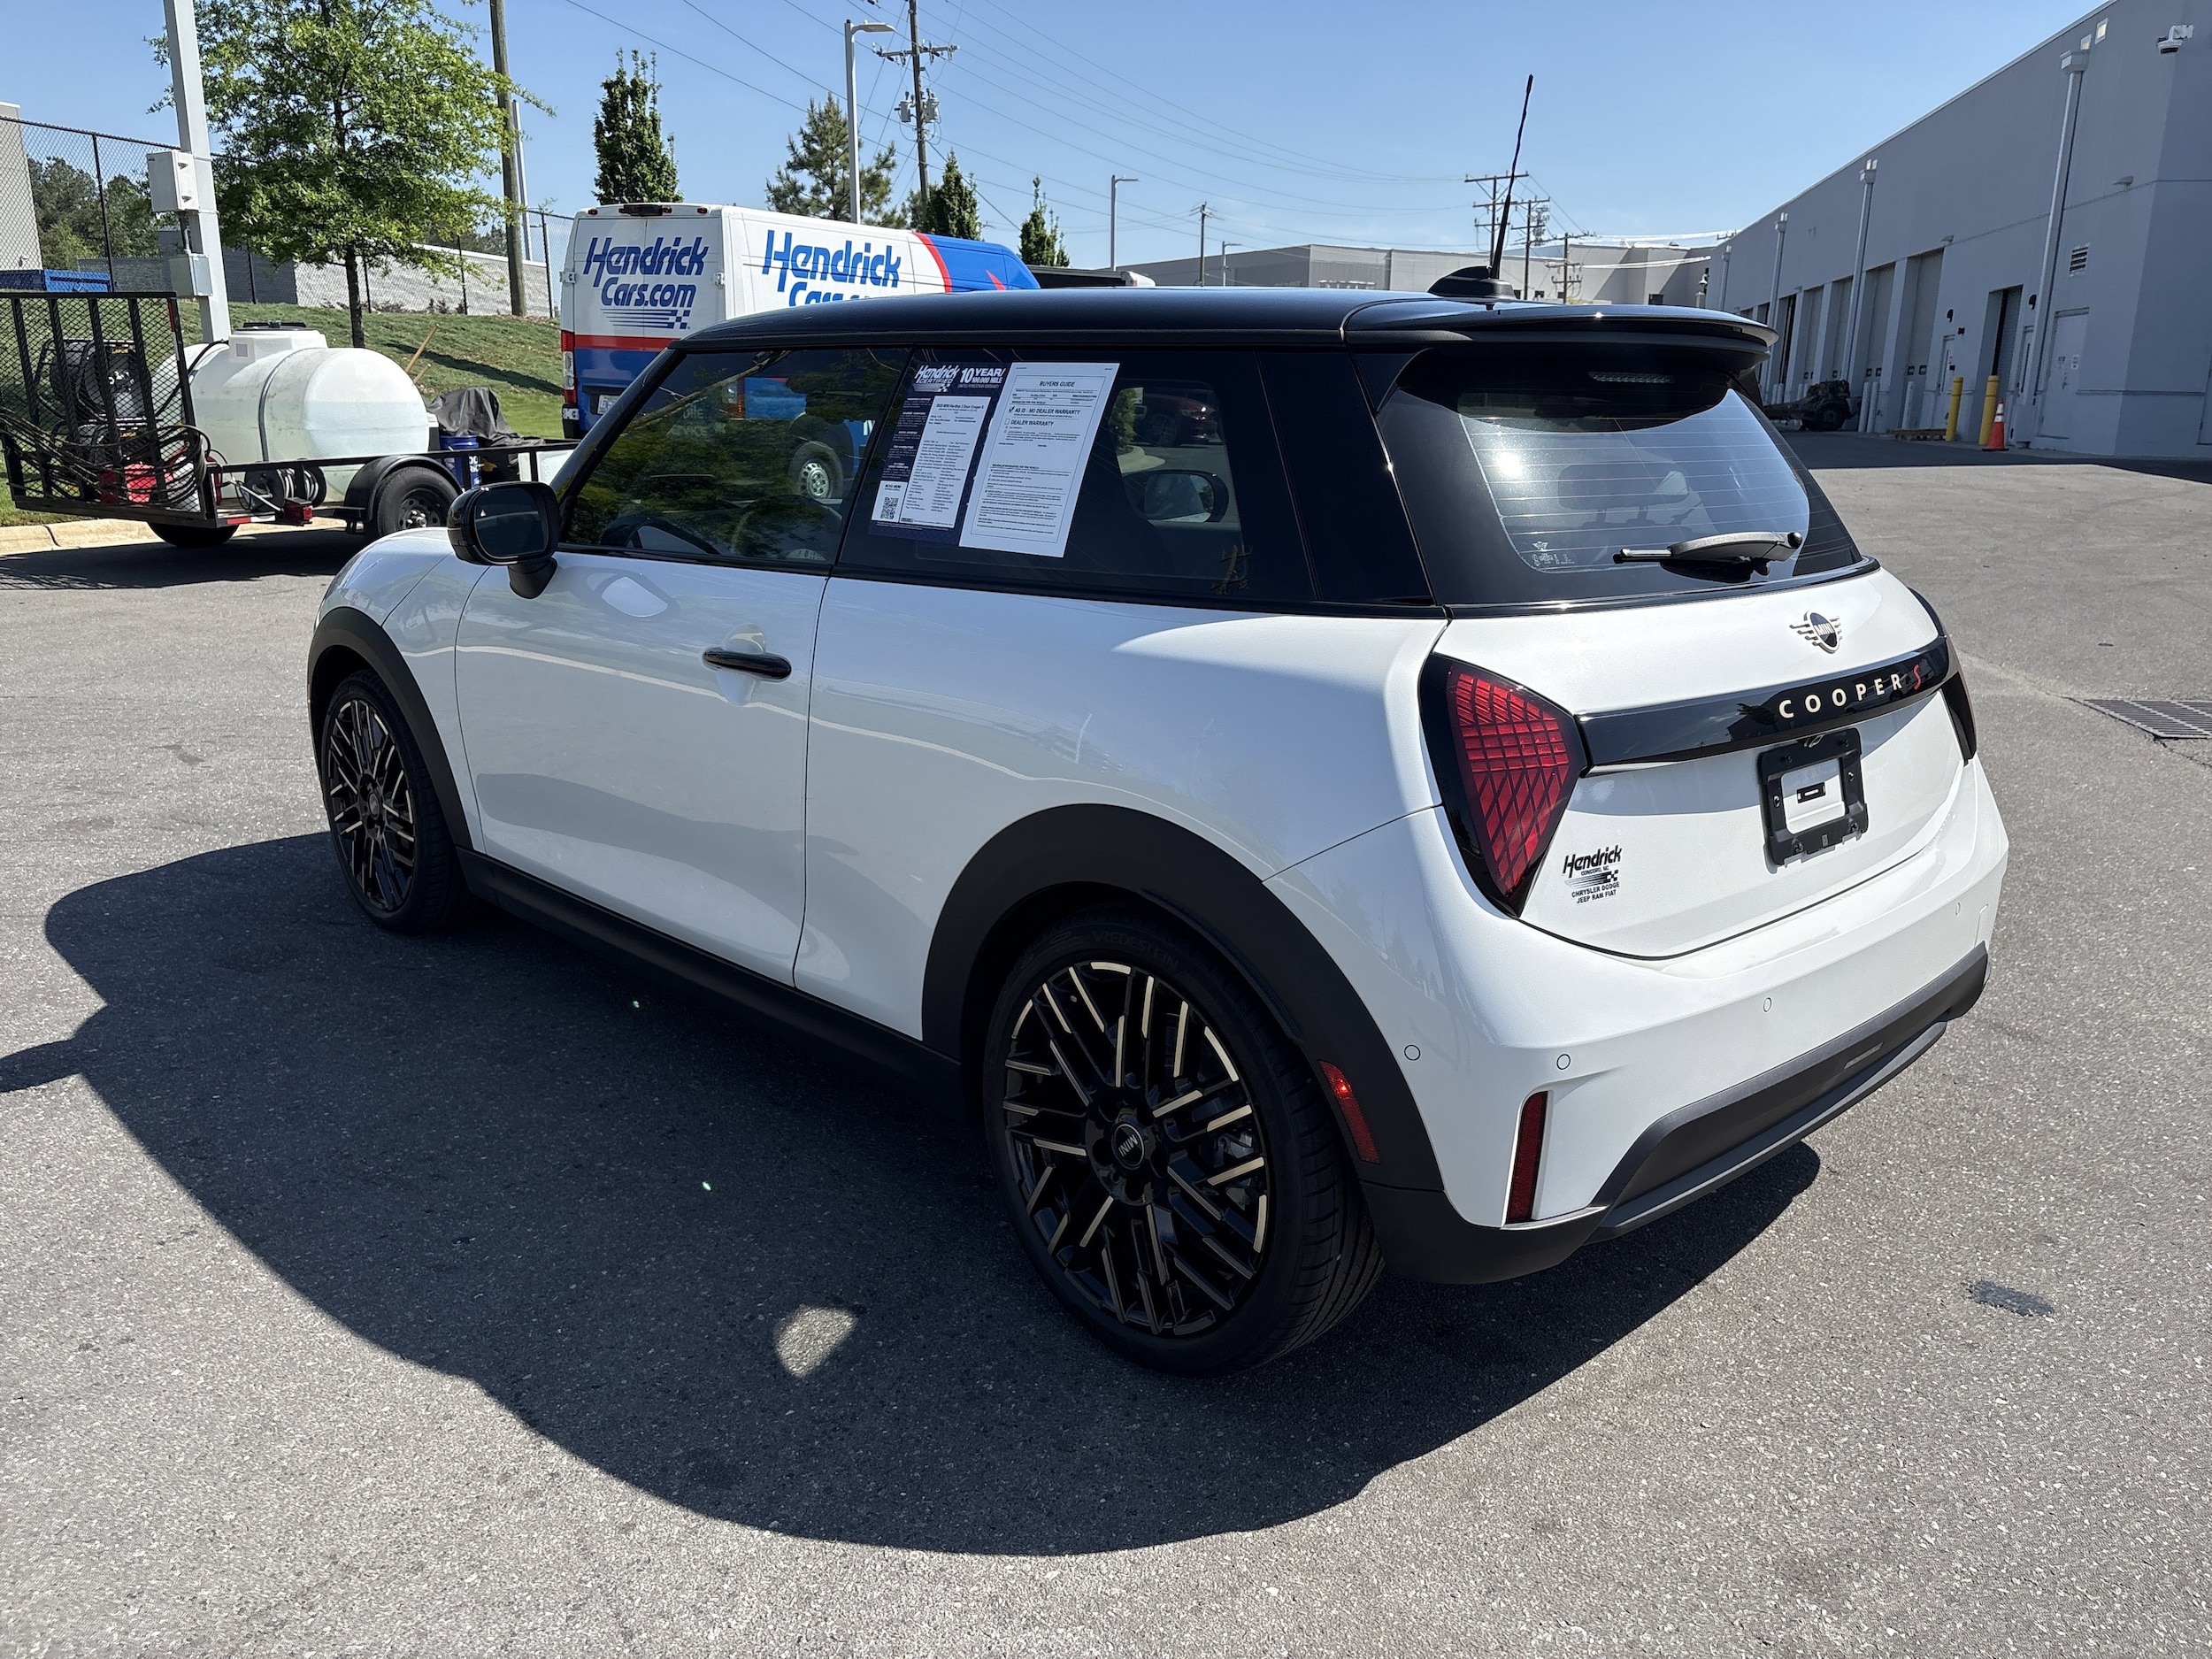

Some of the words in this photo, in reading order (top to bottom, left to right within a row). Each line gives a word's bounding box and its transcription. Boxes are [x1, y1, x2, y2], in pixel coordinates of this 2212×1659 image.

[583, 237, 709, 288] Hendrick
[762, 229, 902, 292] Hendrick
[601, 277, 697, 308] Cars.com
[914, 365, 961, 383] Hendrick
[960, 368, 975, 383] 10
[975, 368, 1006, 377] YEAR/
[1813, 622, 1835, 636] MINI
[1778, 673, 1902, 718] COOPER
[1913, 664, 1922, 690] S
[1563, 844, 1622, 879] Hendrick
[1571, 886, 1600, 897] CHRYSLER
[1601, 881, 1620, 890] DODGE
[1092, 929, 1179, 971] VREDESTEIN
